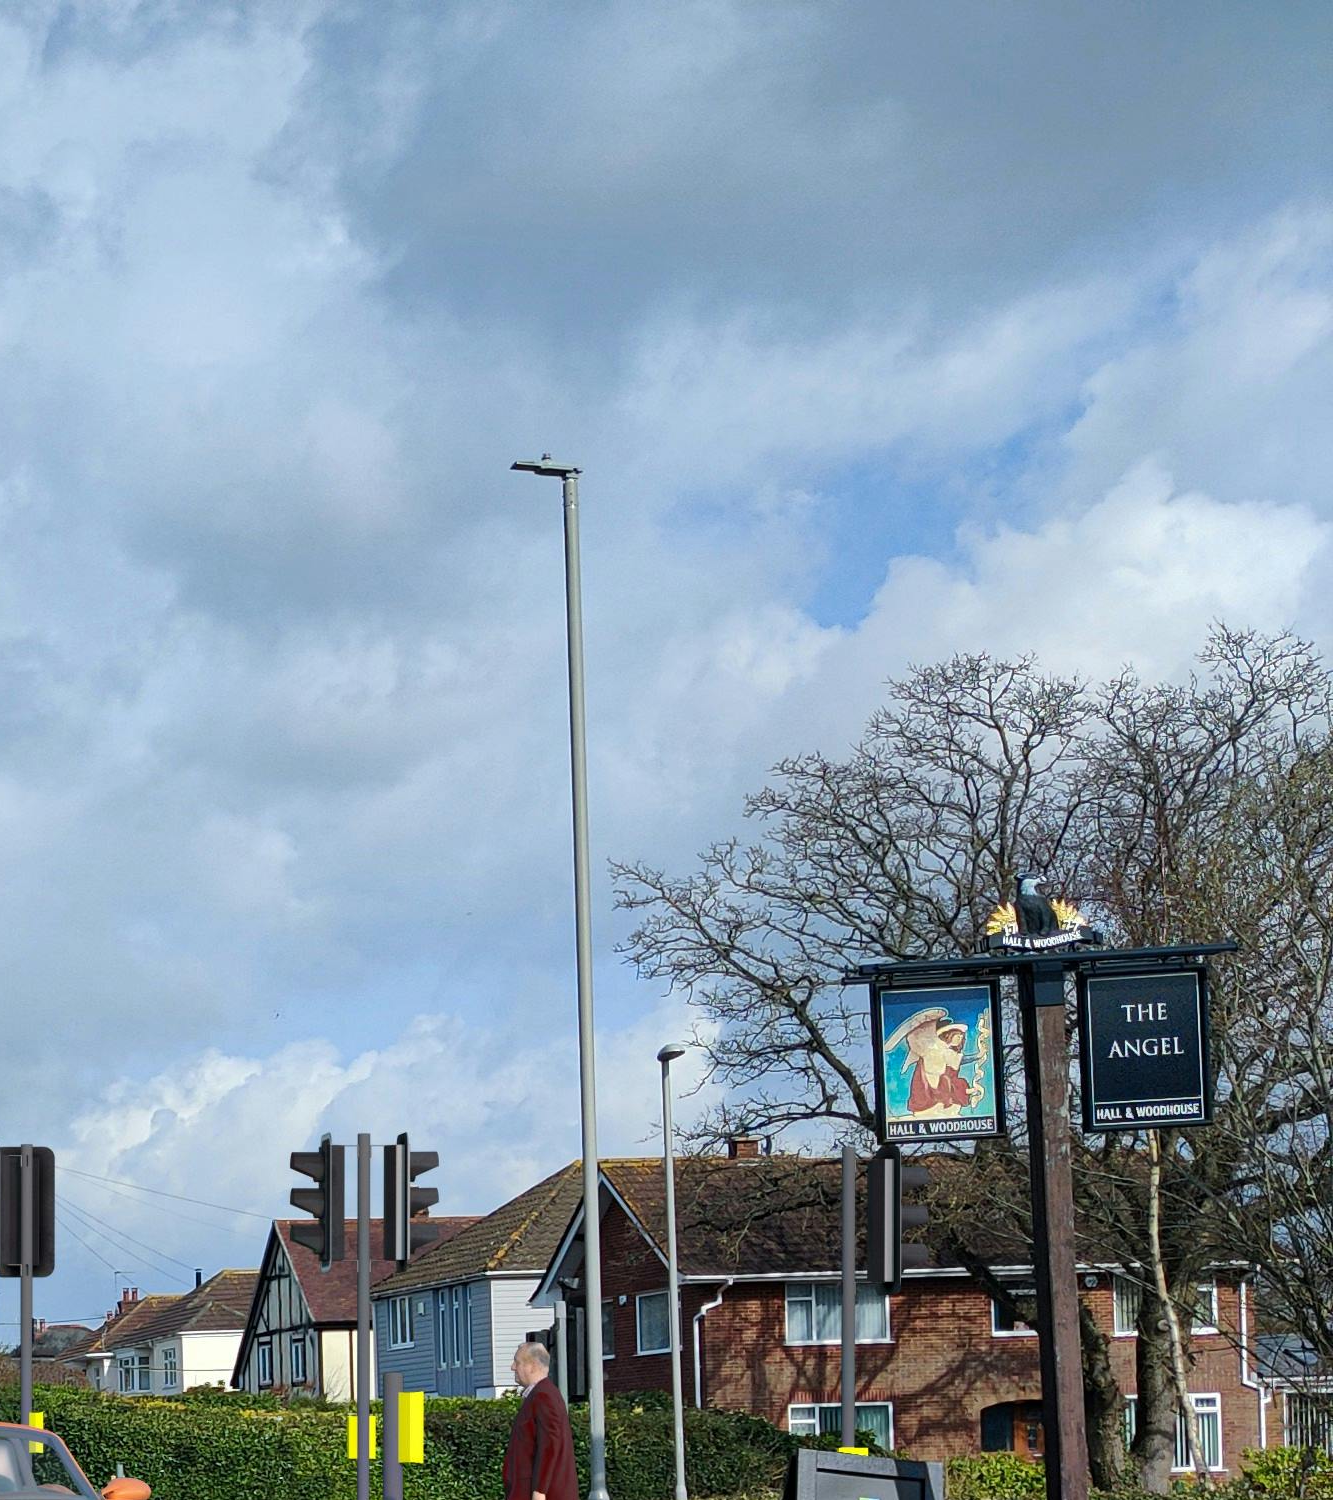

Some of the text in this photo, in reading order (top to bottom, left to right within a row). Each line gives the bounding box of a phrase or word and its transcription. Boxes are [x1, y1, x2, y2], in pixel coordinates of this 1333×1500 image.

[1002, 930, 1084, 949] HALL & WOODHOUSE
[1120, 1002, 1168, 1023] THE
[1107, 1036, 1185, 1059] ANGEL
[1096, 1102, 1200, 1120] HALL & WOODHOUSE
[889, 1118, 994, 1136] HALL & WOODHOUSE
